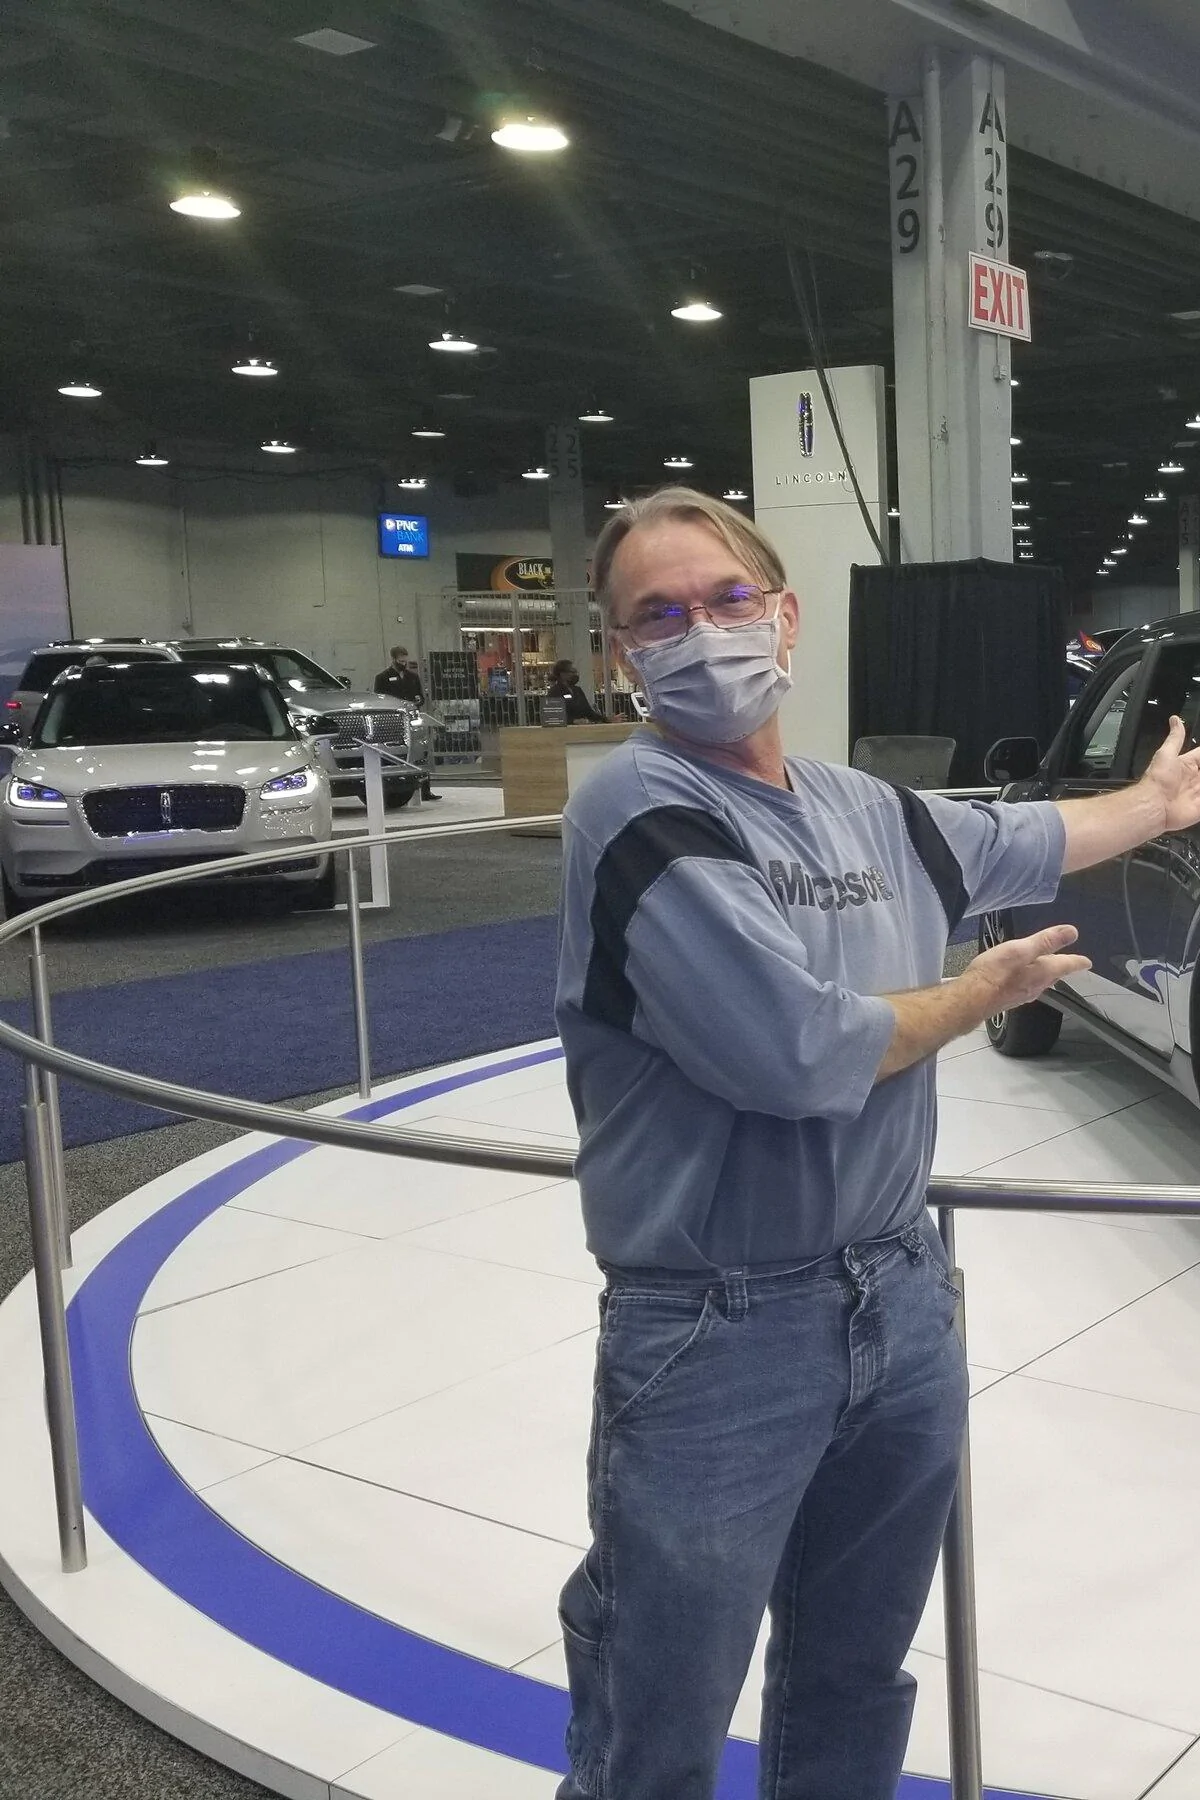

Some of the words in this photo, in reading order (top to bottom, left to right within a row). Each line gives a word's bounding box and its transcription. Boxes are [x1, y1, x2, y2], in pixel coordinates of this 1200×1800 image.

[889, 100, 921, 254] A29
[979, 93, 1005, 248] A29
[974, 263, 1025, 330] EXIT
[775, 471, 847, 485] LINCOLN
[395, 519, 419, 532] PNC
[397, 531, 424, 542] BANK
[398, 543, 414, 553] ATM
[518, 562, 544, 576] BLACK
